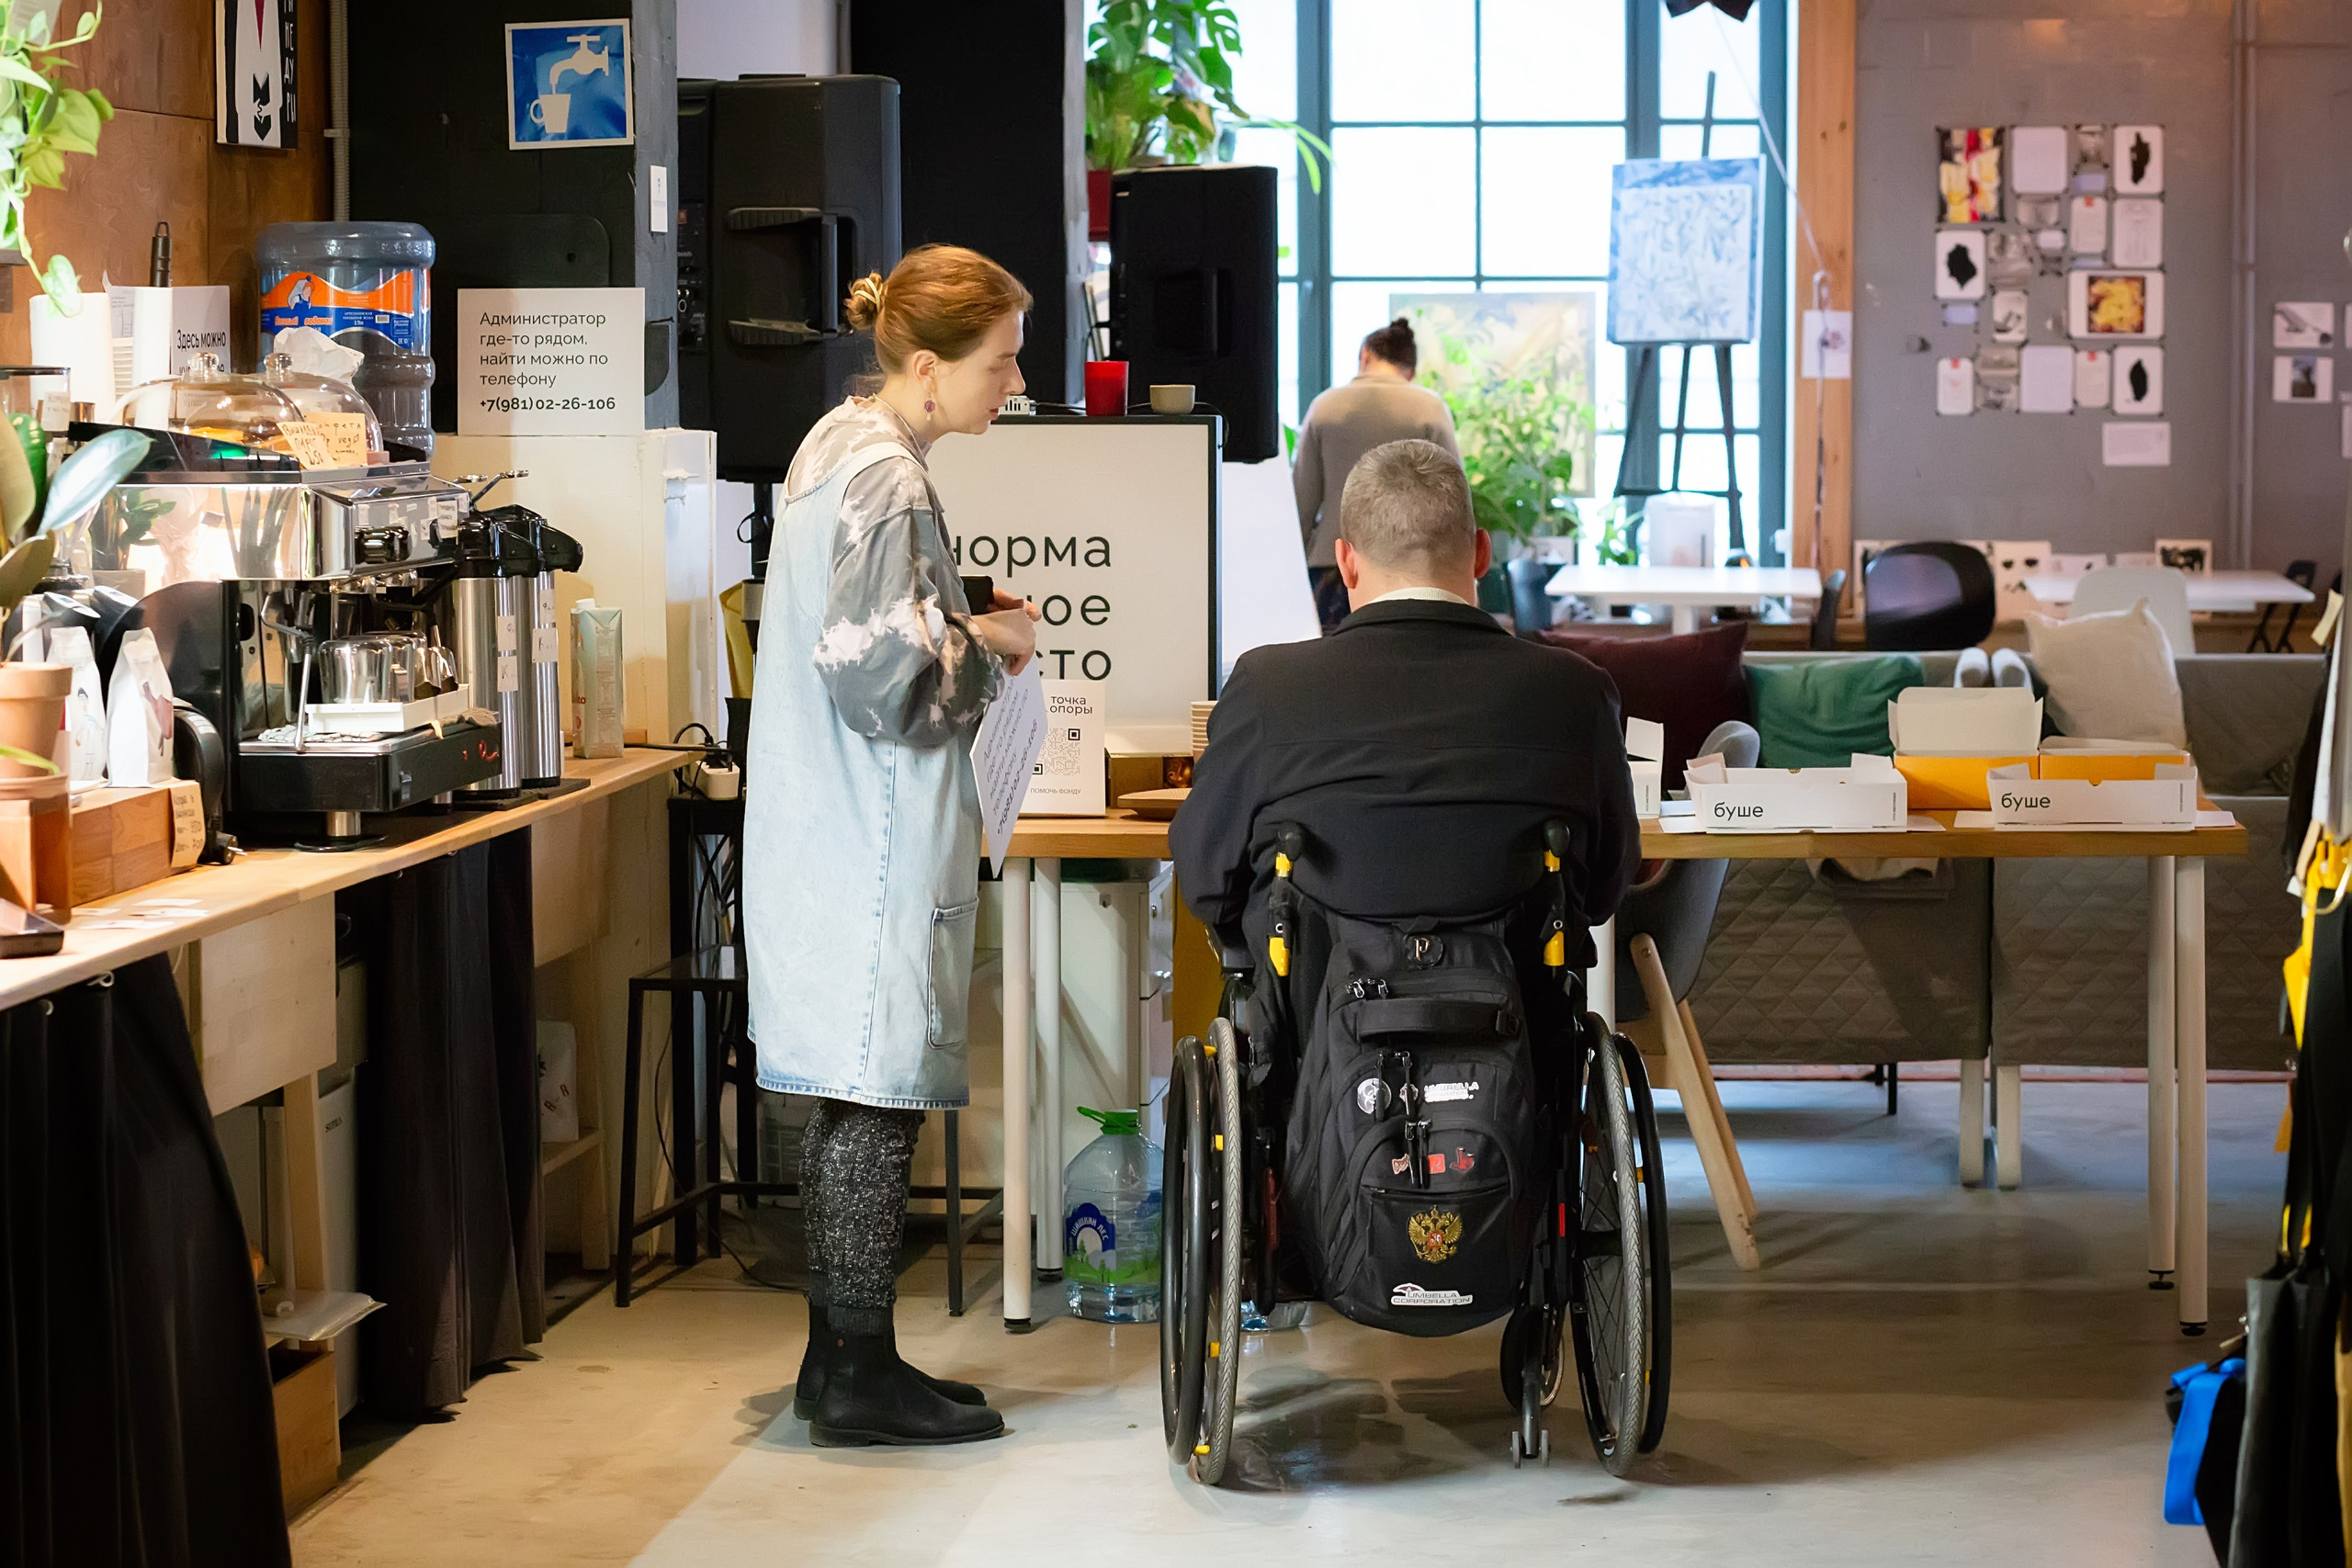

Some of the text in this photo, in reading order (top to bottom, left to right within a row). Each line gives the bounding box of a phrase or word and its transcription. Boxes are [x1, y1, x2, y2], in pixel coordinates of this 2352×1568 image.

[480, 311, 606, 328] Администратор
[176, 329, 227, 353] Здесь можно
[480, 333, 530, 347] где-то
[480, 352, 608, 366] найти можно по
[480, 371, 557, 389] телефону
[953, 536, 1112, 578] норма
[1050, 695, 1087, 705] точка
[1049, 705, 1093, 716] опоры
[2001, 792, 2051, 812] буше
[1713, 801, 1764, 821] буше
[1070, 1216, 1109, 1241] ШИШКИН ЛЕС
[1393, 1296, 1471, 1304] CORPORATION
